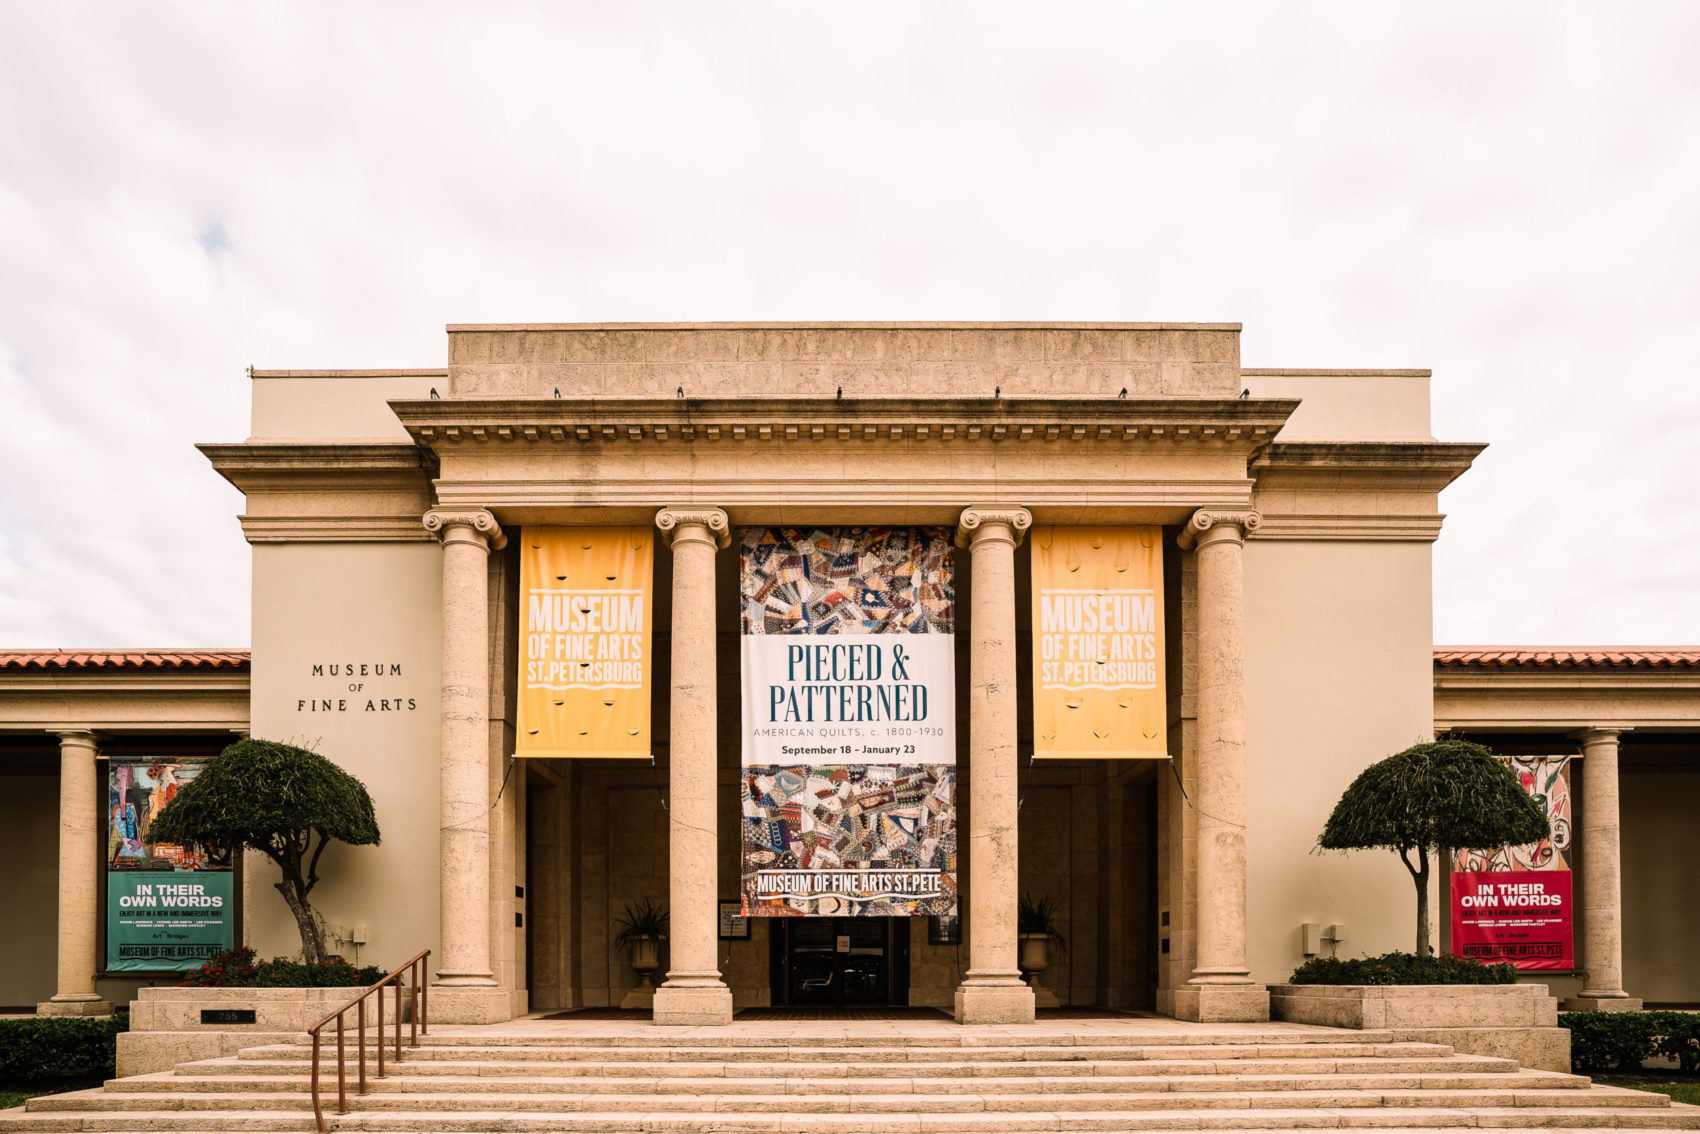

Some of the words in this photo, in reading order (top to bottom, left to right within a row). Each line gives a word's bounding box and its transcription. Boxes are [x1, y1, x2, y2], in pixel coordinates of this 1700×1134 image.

[528, 596, 643, 632] MUSEUM
[1041, 596, 1155, 632] MUSEUM
[528, 634, 550, 660] OF
[555, 634, 594, 660] FINE
[596, 634, 642, 660] ARTS
[1042, 634, 1064, 660] OF
[1068, 634, 1107, 660] FINE
[1110, 634, 1156, 660] ARTS
[788, 644, 882, 682] PIECED
[892, 644, 910, 681] &
[312, 664, 401, 676] MUSEUM
[348, 684, 364, 692] OF
[298, 700, 346, 711] FINE
[365, 698, 416, 711] ARTS
[769, 684, 928, 722] PATTERNED
[754, 728, 814, 737] AMERICAN
[820, 728, 865, 738] QUILTS,
[886, 728, 944, 736] 1800-1930
[782, 746, 837, 756] September
[840, 746, 851, 754] 18
[862, 745, 900, 756] January
[904, 745, 916, 754] 23
[758, 874, 811, 892] MUSEUM
[814, 874, 829, 892] OF
[832, 874, 858, 892] FINE
[861, 874, 892, 892] ARTS
[136, 884, 152, 895] IN
[156, 884, 204, 895] THEIR
[1478, 884, 1493, 895] IN
[1498, 884, 1544, 894] THEIR
[120, 896, 156, 907] OWN
[161, 896, 223, 907] WORDS
[1461, 896, 1498, 907] OWN
[1502, 895, 1562, 906] WORDS
[120, 947, 149, 956] MUSEUM
[151, 947, 159, 956] OF
[161, 947, 176, 956] FINE
[177, 947, 194, 956] ARTS
[1463, 946, 1492, 956] MUSEUM
[1494, 946, 1502, 956] OF
[1503, 946, 1517, 955] FINE
[1519, 945, 1535, 955] ARTS
